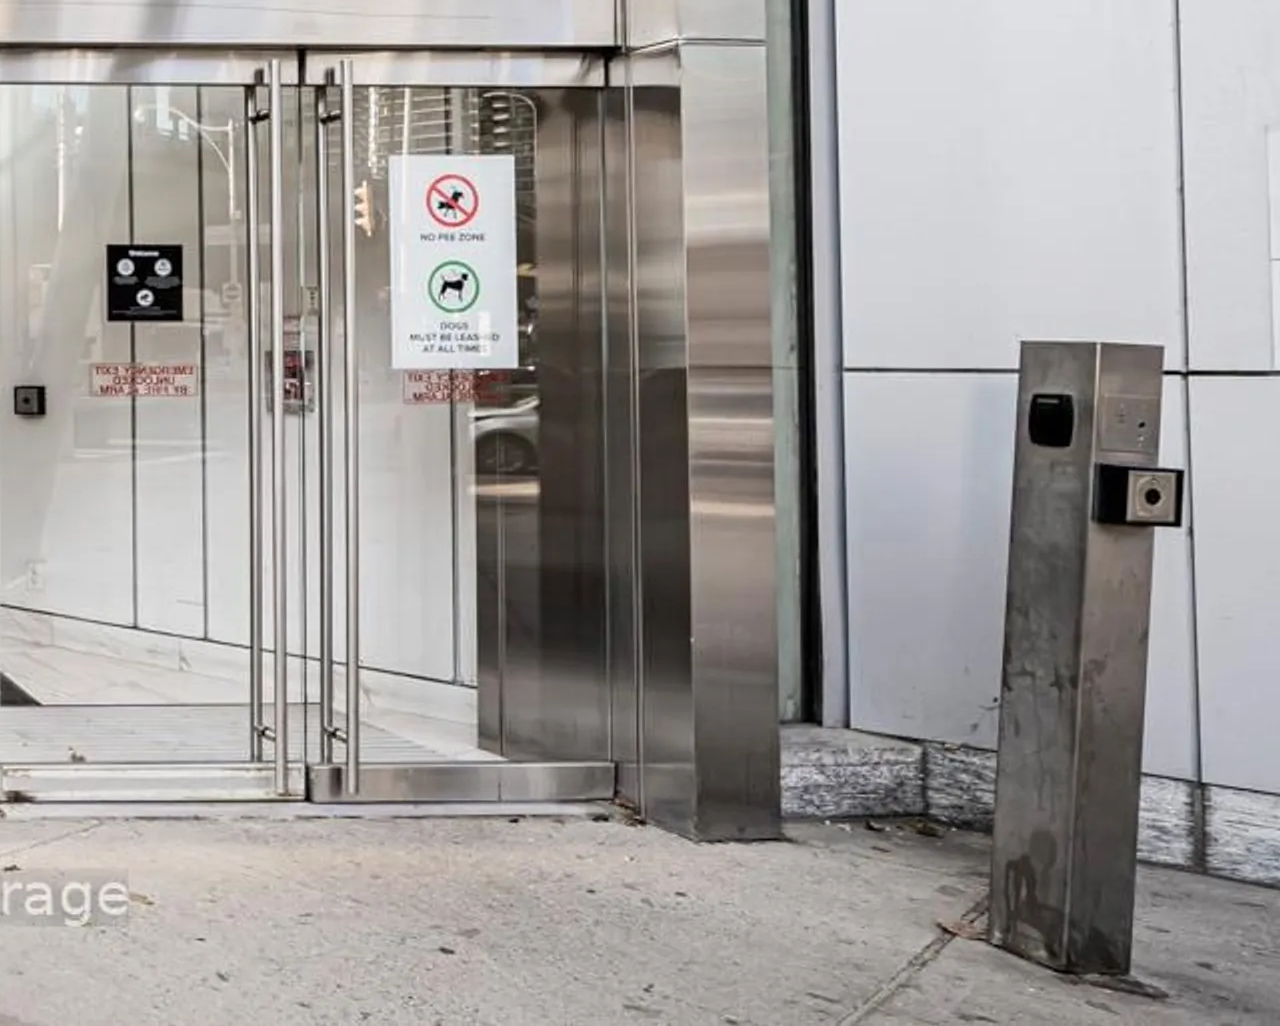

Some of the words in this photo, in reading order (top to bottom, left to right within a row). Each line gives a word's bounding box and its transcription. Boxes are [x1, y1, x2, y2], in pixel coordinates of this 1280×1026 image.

[420, 233, 436, 243] NO
[438, 233, 456, 243] PEE
[458, 233, 486, 243] ZONE
[440, 321, 469, 331] DOGS
[409, 333, 437, 342] MUST
[440, 333, 452, 342] BE
[454, 333, 500, 342] LEASD
[421, 344, 435, 353] AT
[438, 344, 455, 353] ALL
